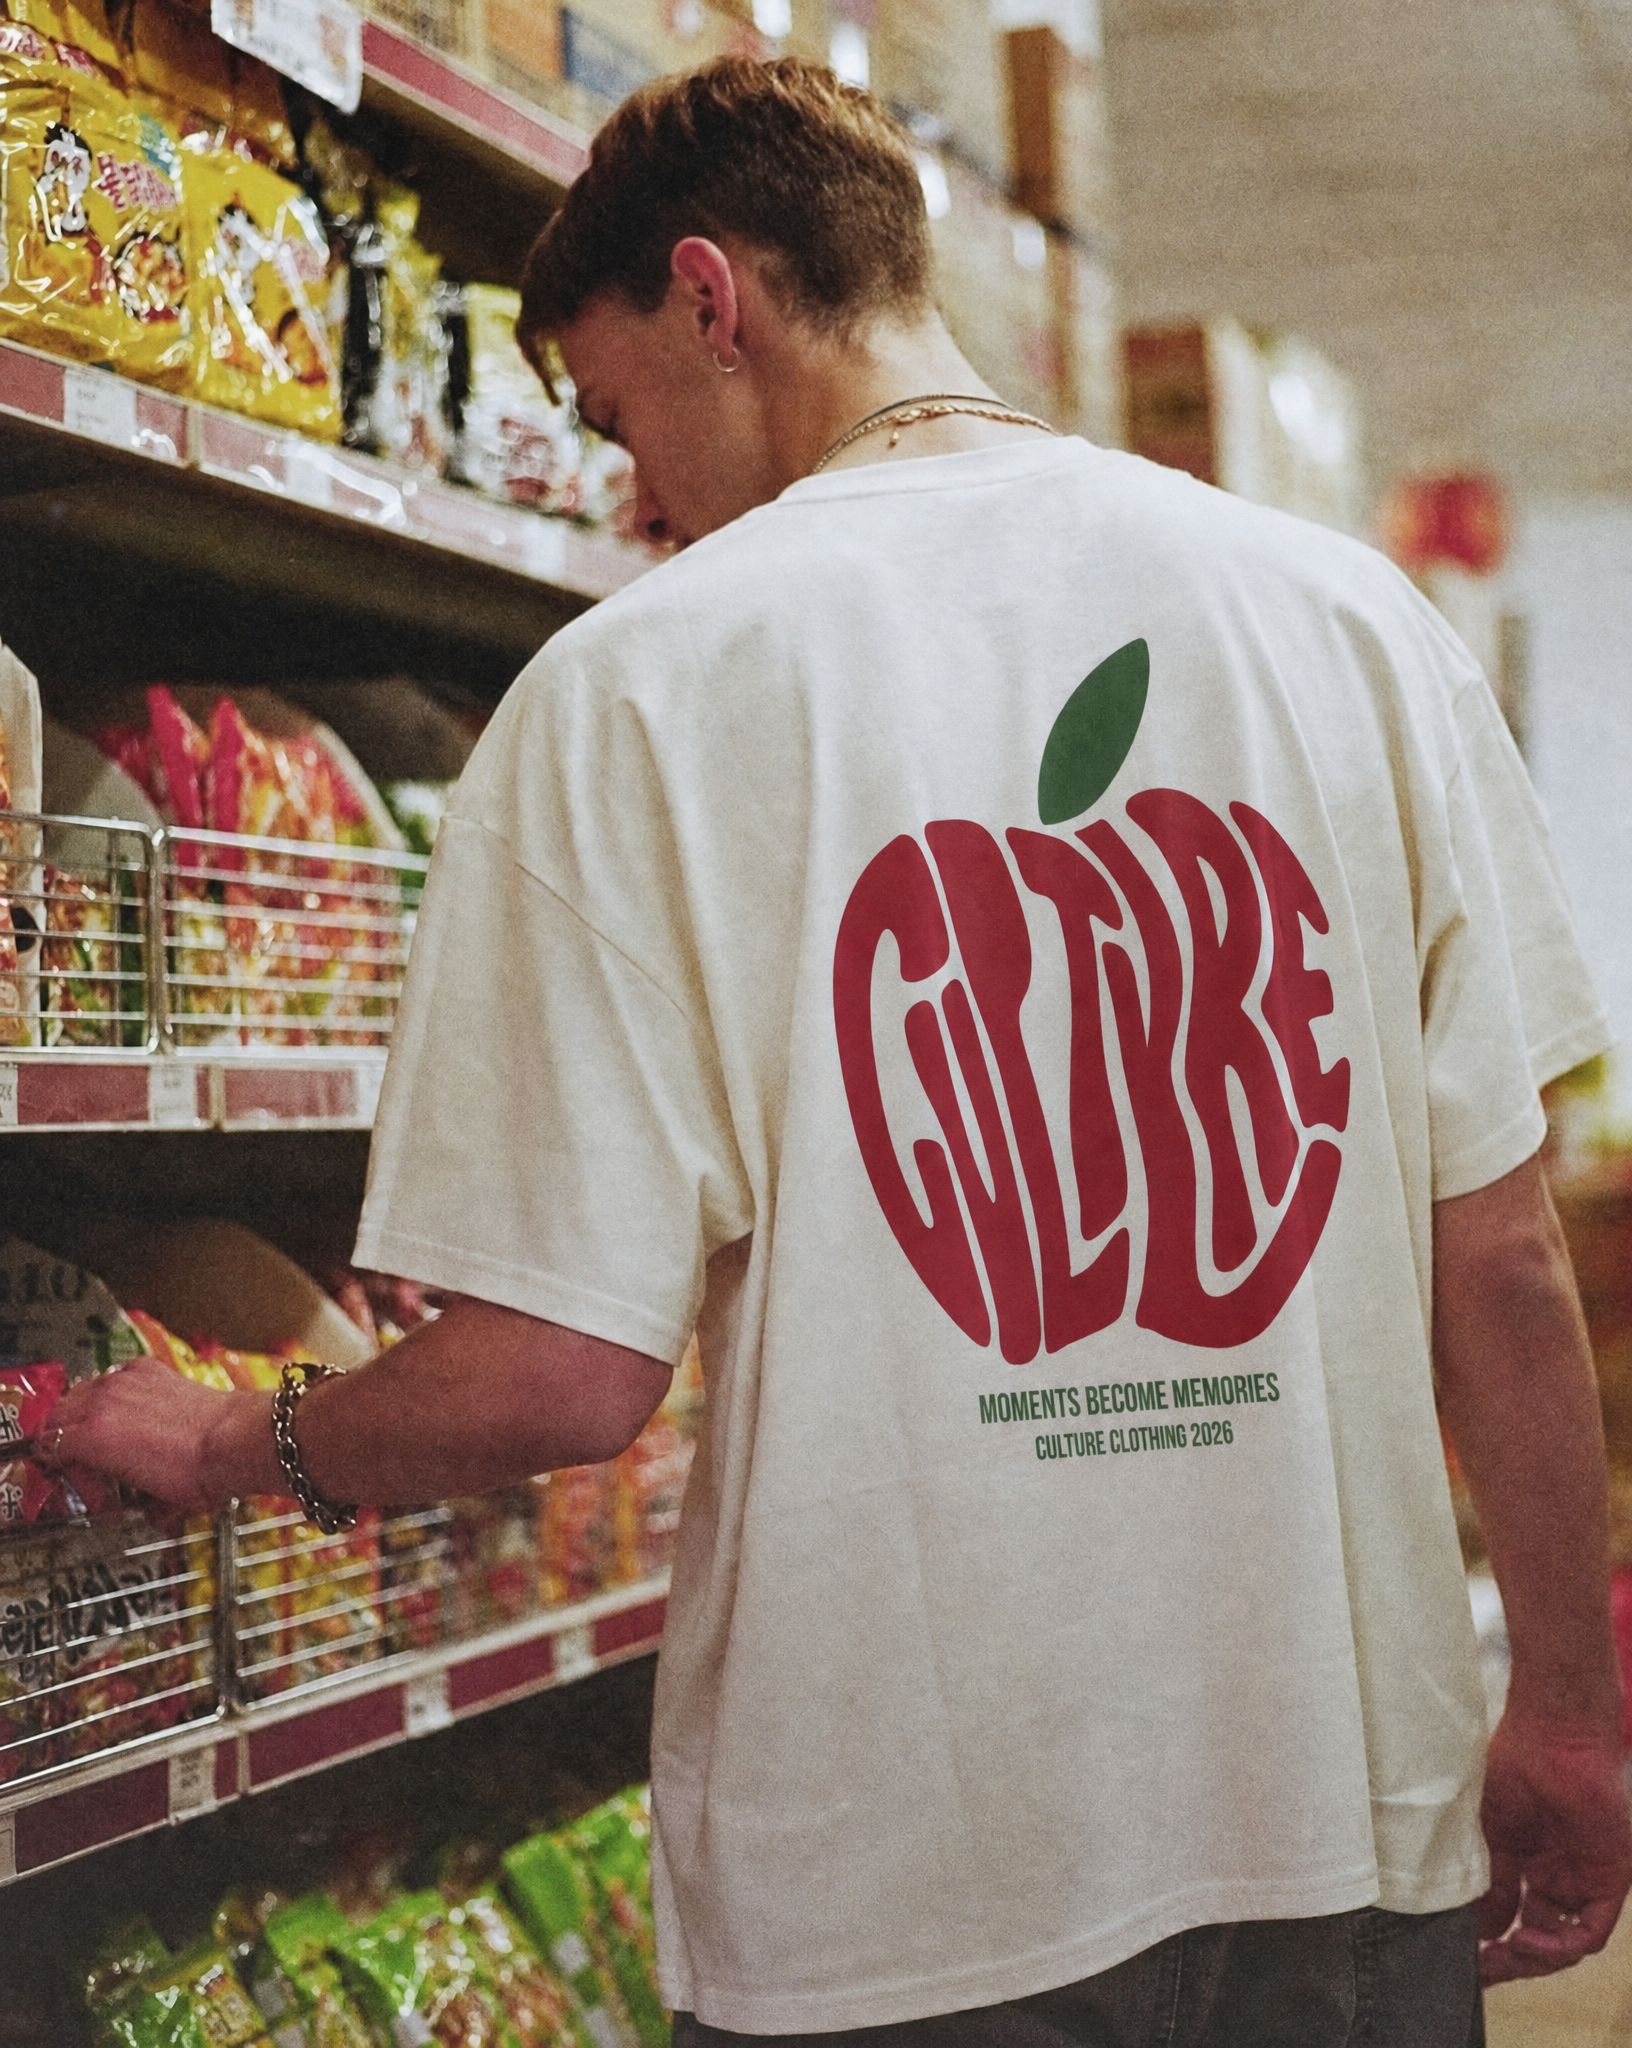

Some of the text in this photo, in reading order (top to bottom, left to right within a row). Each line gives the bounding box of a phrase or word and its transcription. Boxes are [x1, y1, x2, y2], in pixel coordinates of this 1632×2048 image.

[833, 788, 1351, 1365] CULTURE
[978, 1372, 1280, 1424] MOMENTS BECOME MEMORIES
[1035, 1420, 1234, 1460] CULTURE CLOTHING 2026
